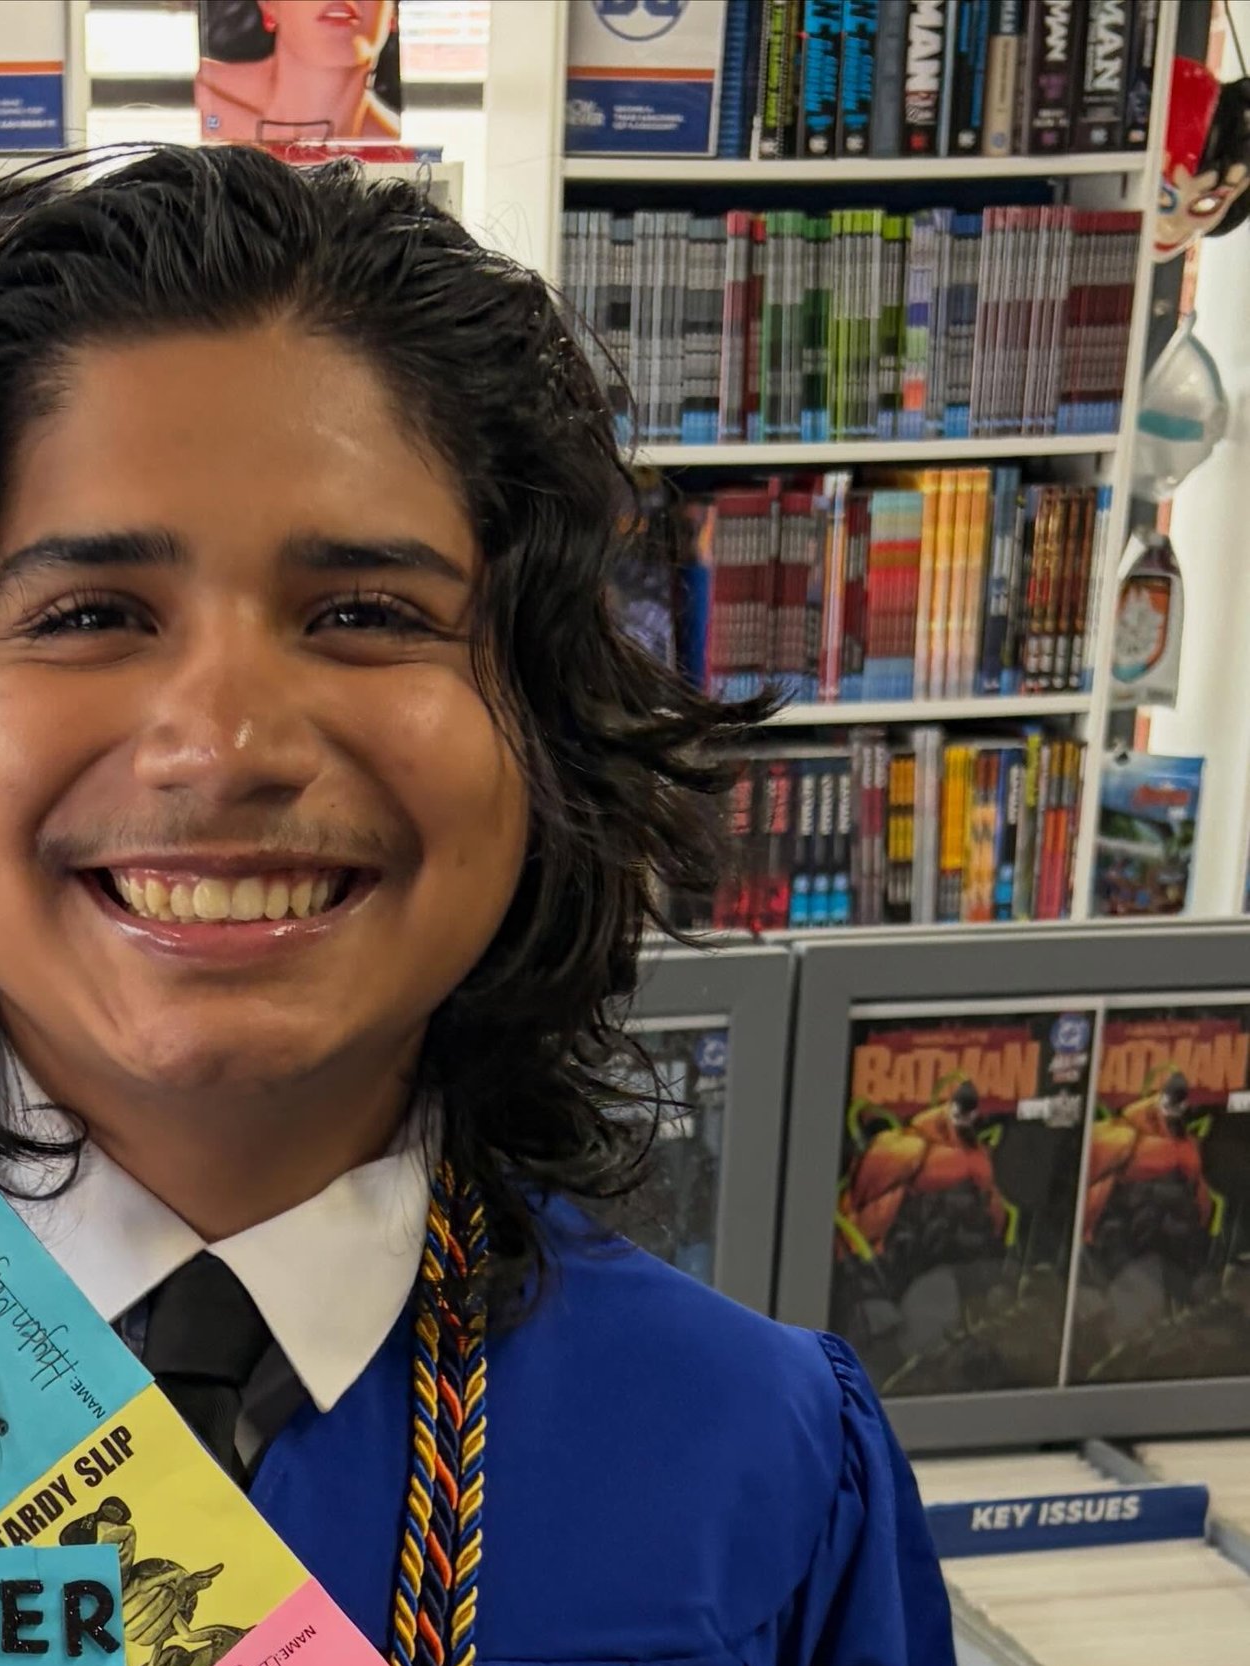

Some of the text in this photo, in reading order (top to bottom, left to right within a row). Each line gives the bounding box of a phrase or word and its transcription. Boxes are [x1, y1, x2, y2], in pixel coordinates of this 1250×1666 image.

[852, 1041, 1041, 1104] BATMAN
[1097, 1033, 1250, 1094] ATMAN
[69, 1376, 106, 1419] NAME:
[74, 1425, 135, 1488] SLIP
[971, 1493, 1141, 1532] KEY ISSUES
[279, 1624, 317, 1660] NAME:
